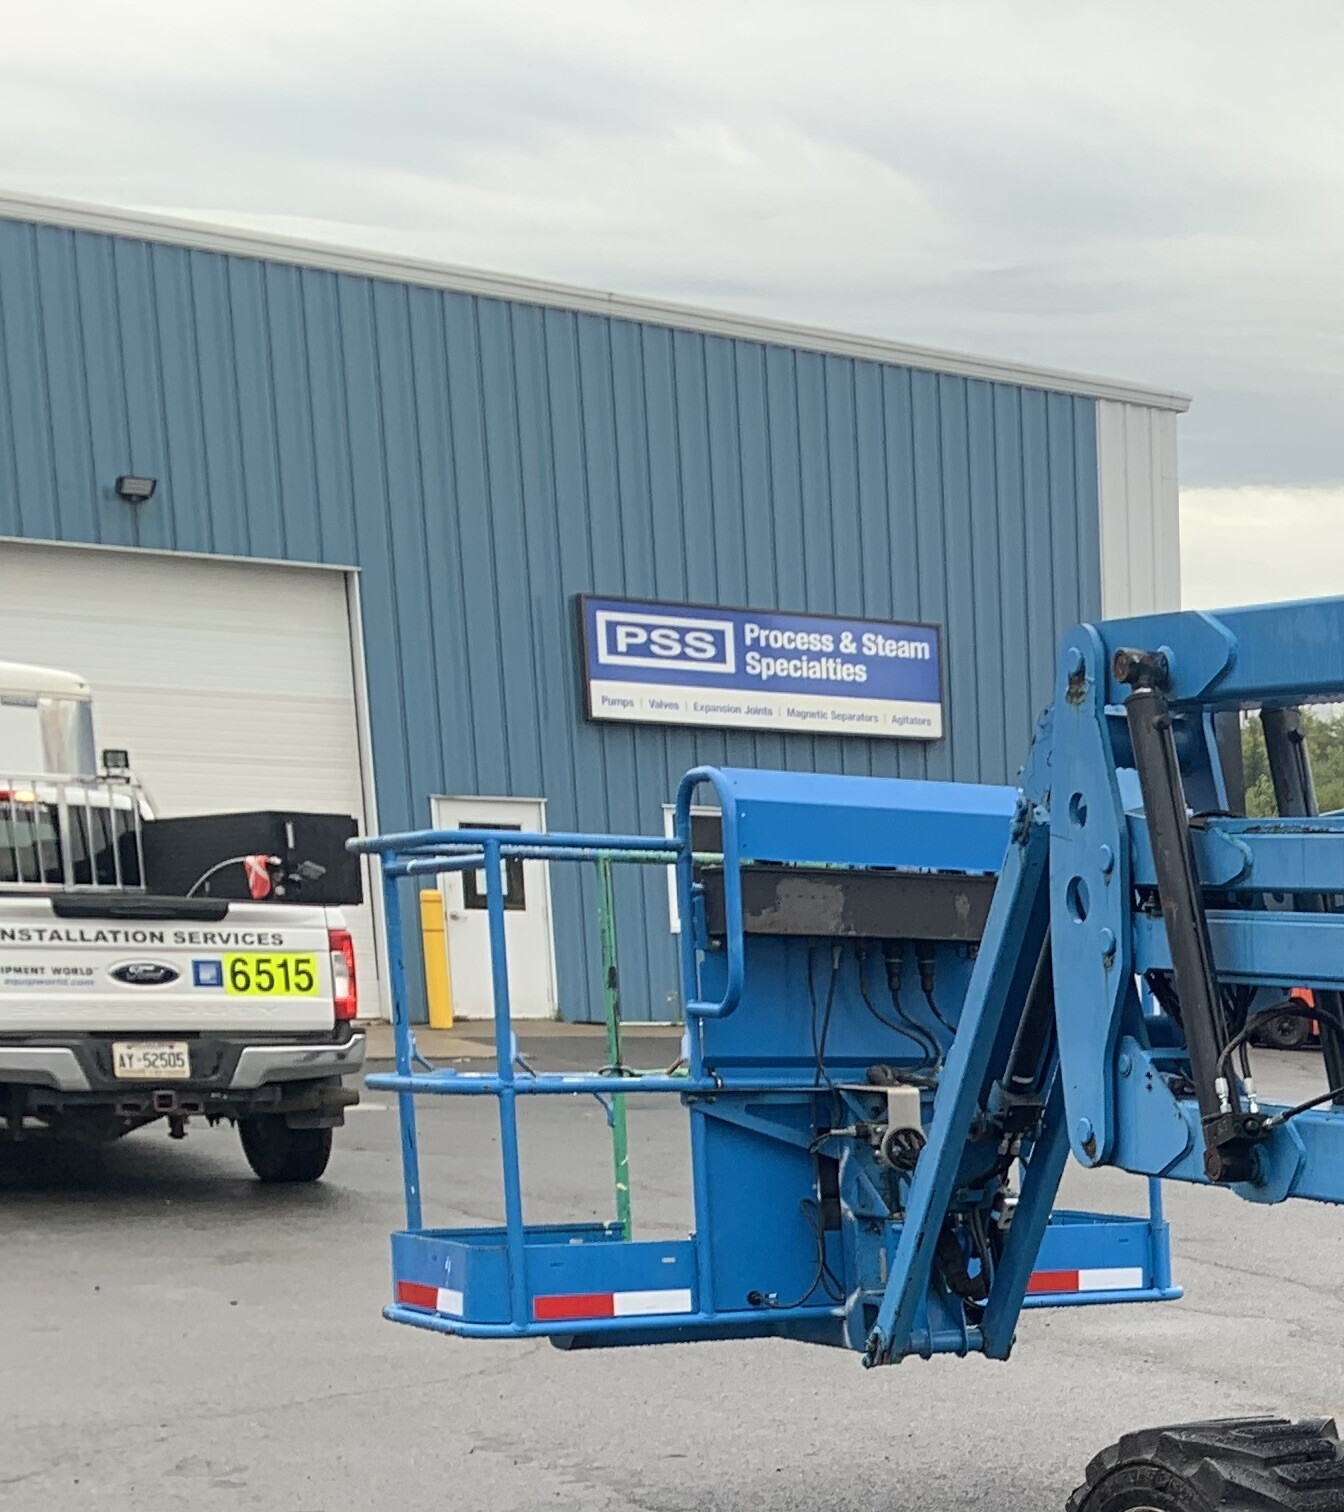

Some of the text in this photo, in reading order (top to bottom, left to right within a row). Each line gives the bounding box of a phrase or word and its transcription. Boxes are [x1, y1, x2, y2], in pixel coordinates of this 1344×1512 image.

[615, 624, 717, 660] PSS
[744, 623, 930, 660] Process & Steam
[745, 652, 867, 682] Specialties
[601, 694, 932, 727] Pumps Valves Expansion Joints Magnetic Separators Agitators
[174, 930, 284, 946] SERVICES
[230, 957, 314, 992] 6515
